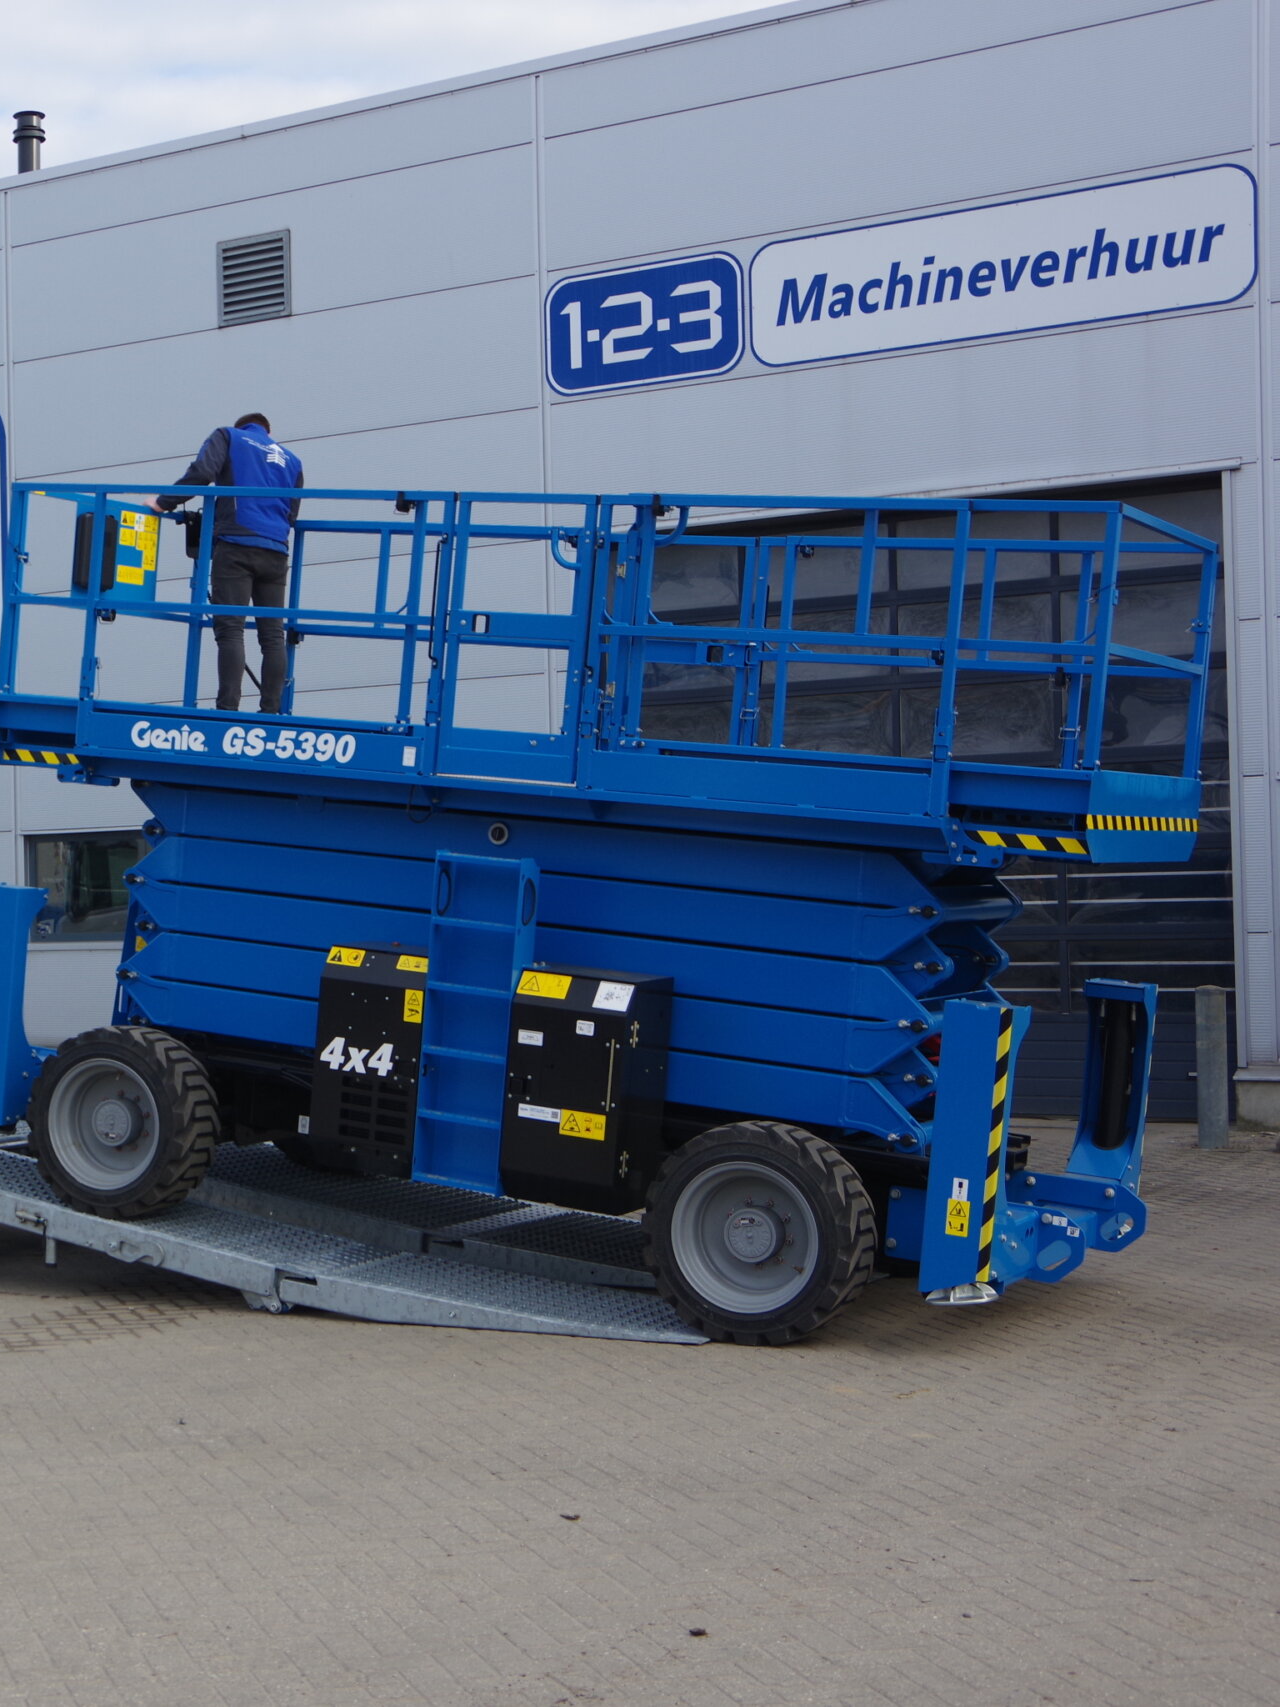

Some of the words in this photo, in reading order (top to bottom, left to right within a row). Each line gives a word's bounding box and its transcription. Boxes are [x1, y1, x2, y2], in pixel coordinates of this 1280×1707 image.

[775, 222, 1226, 327] Machineverhuur
[131, 720, 208, 752] Genie
[222, 726, 356, 764] GS-5390
[320, 1036, 394, 1077] 4x4
